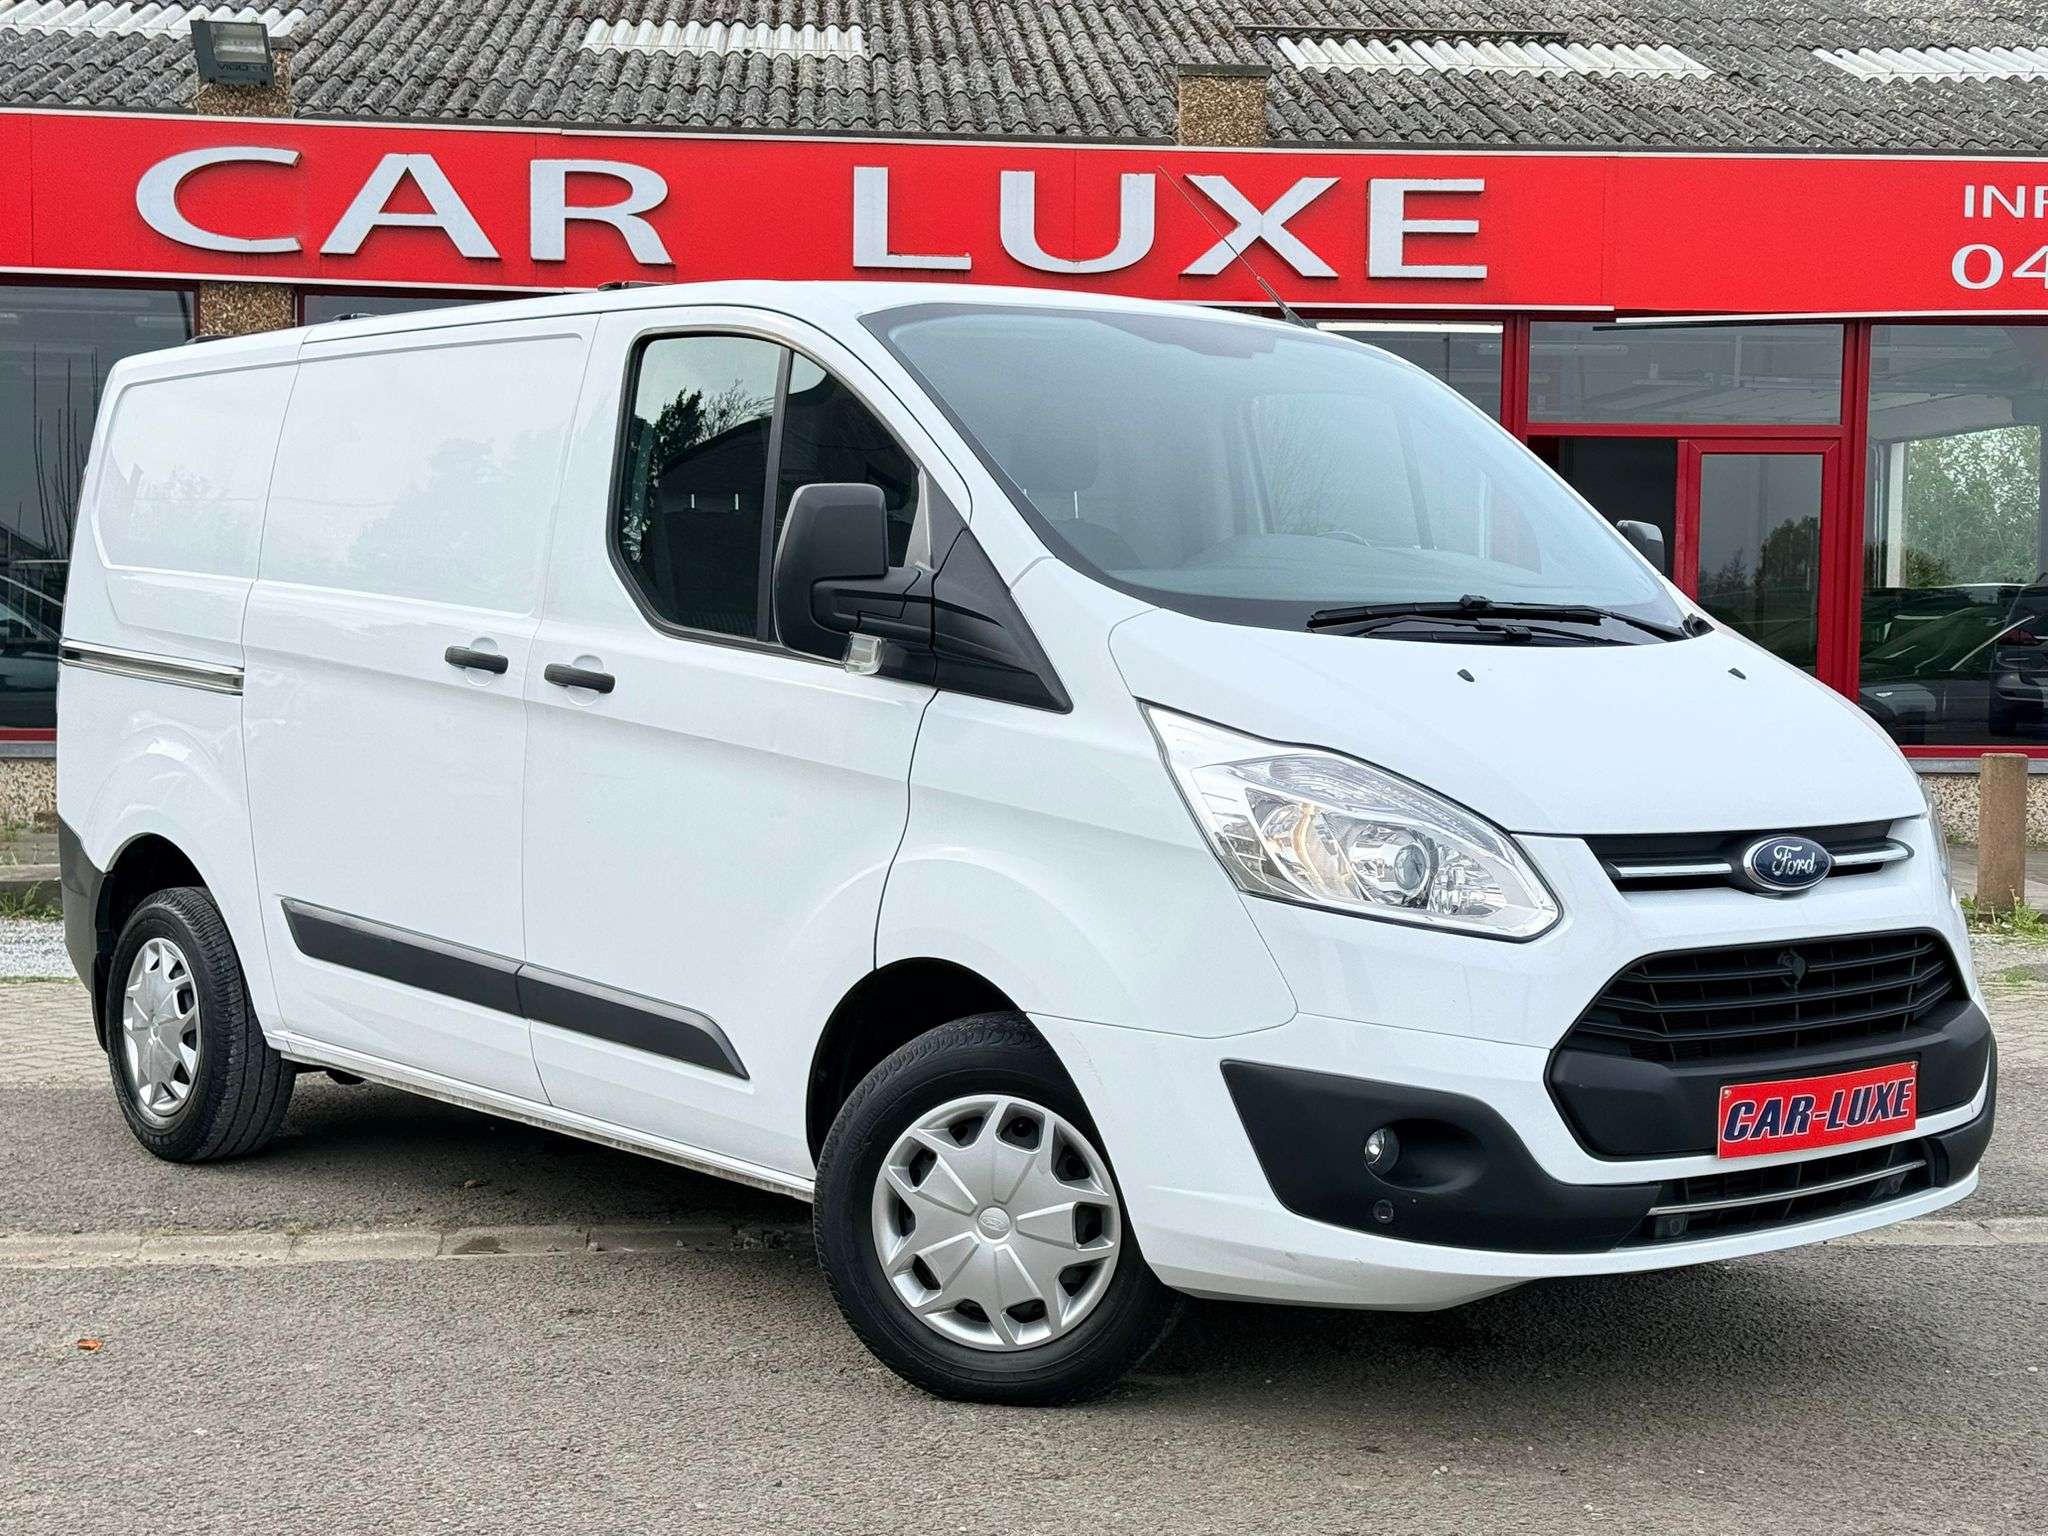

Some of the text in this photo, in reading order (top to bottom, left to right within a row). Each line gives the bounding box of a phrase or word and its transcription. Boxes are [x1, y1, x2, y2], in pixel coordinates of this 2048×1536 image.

[135, 145, 1489, 280] CAR LUXE
[1771, 845, 1817, 876] Ford
[1722, 1078, 1916, 1143] CAR-LUXE
